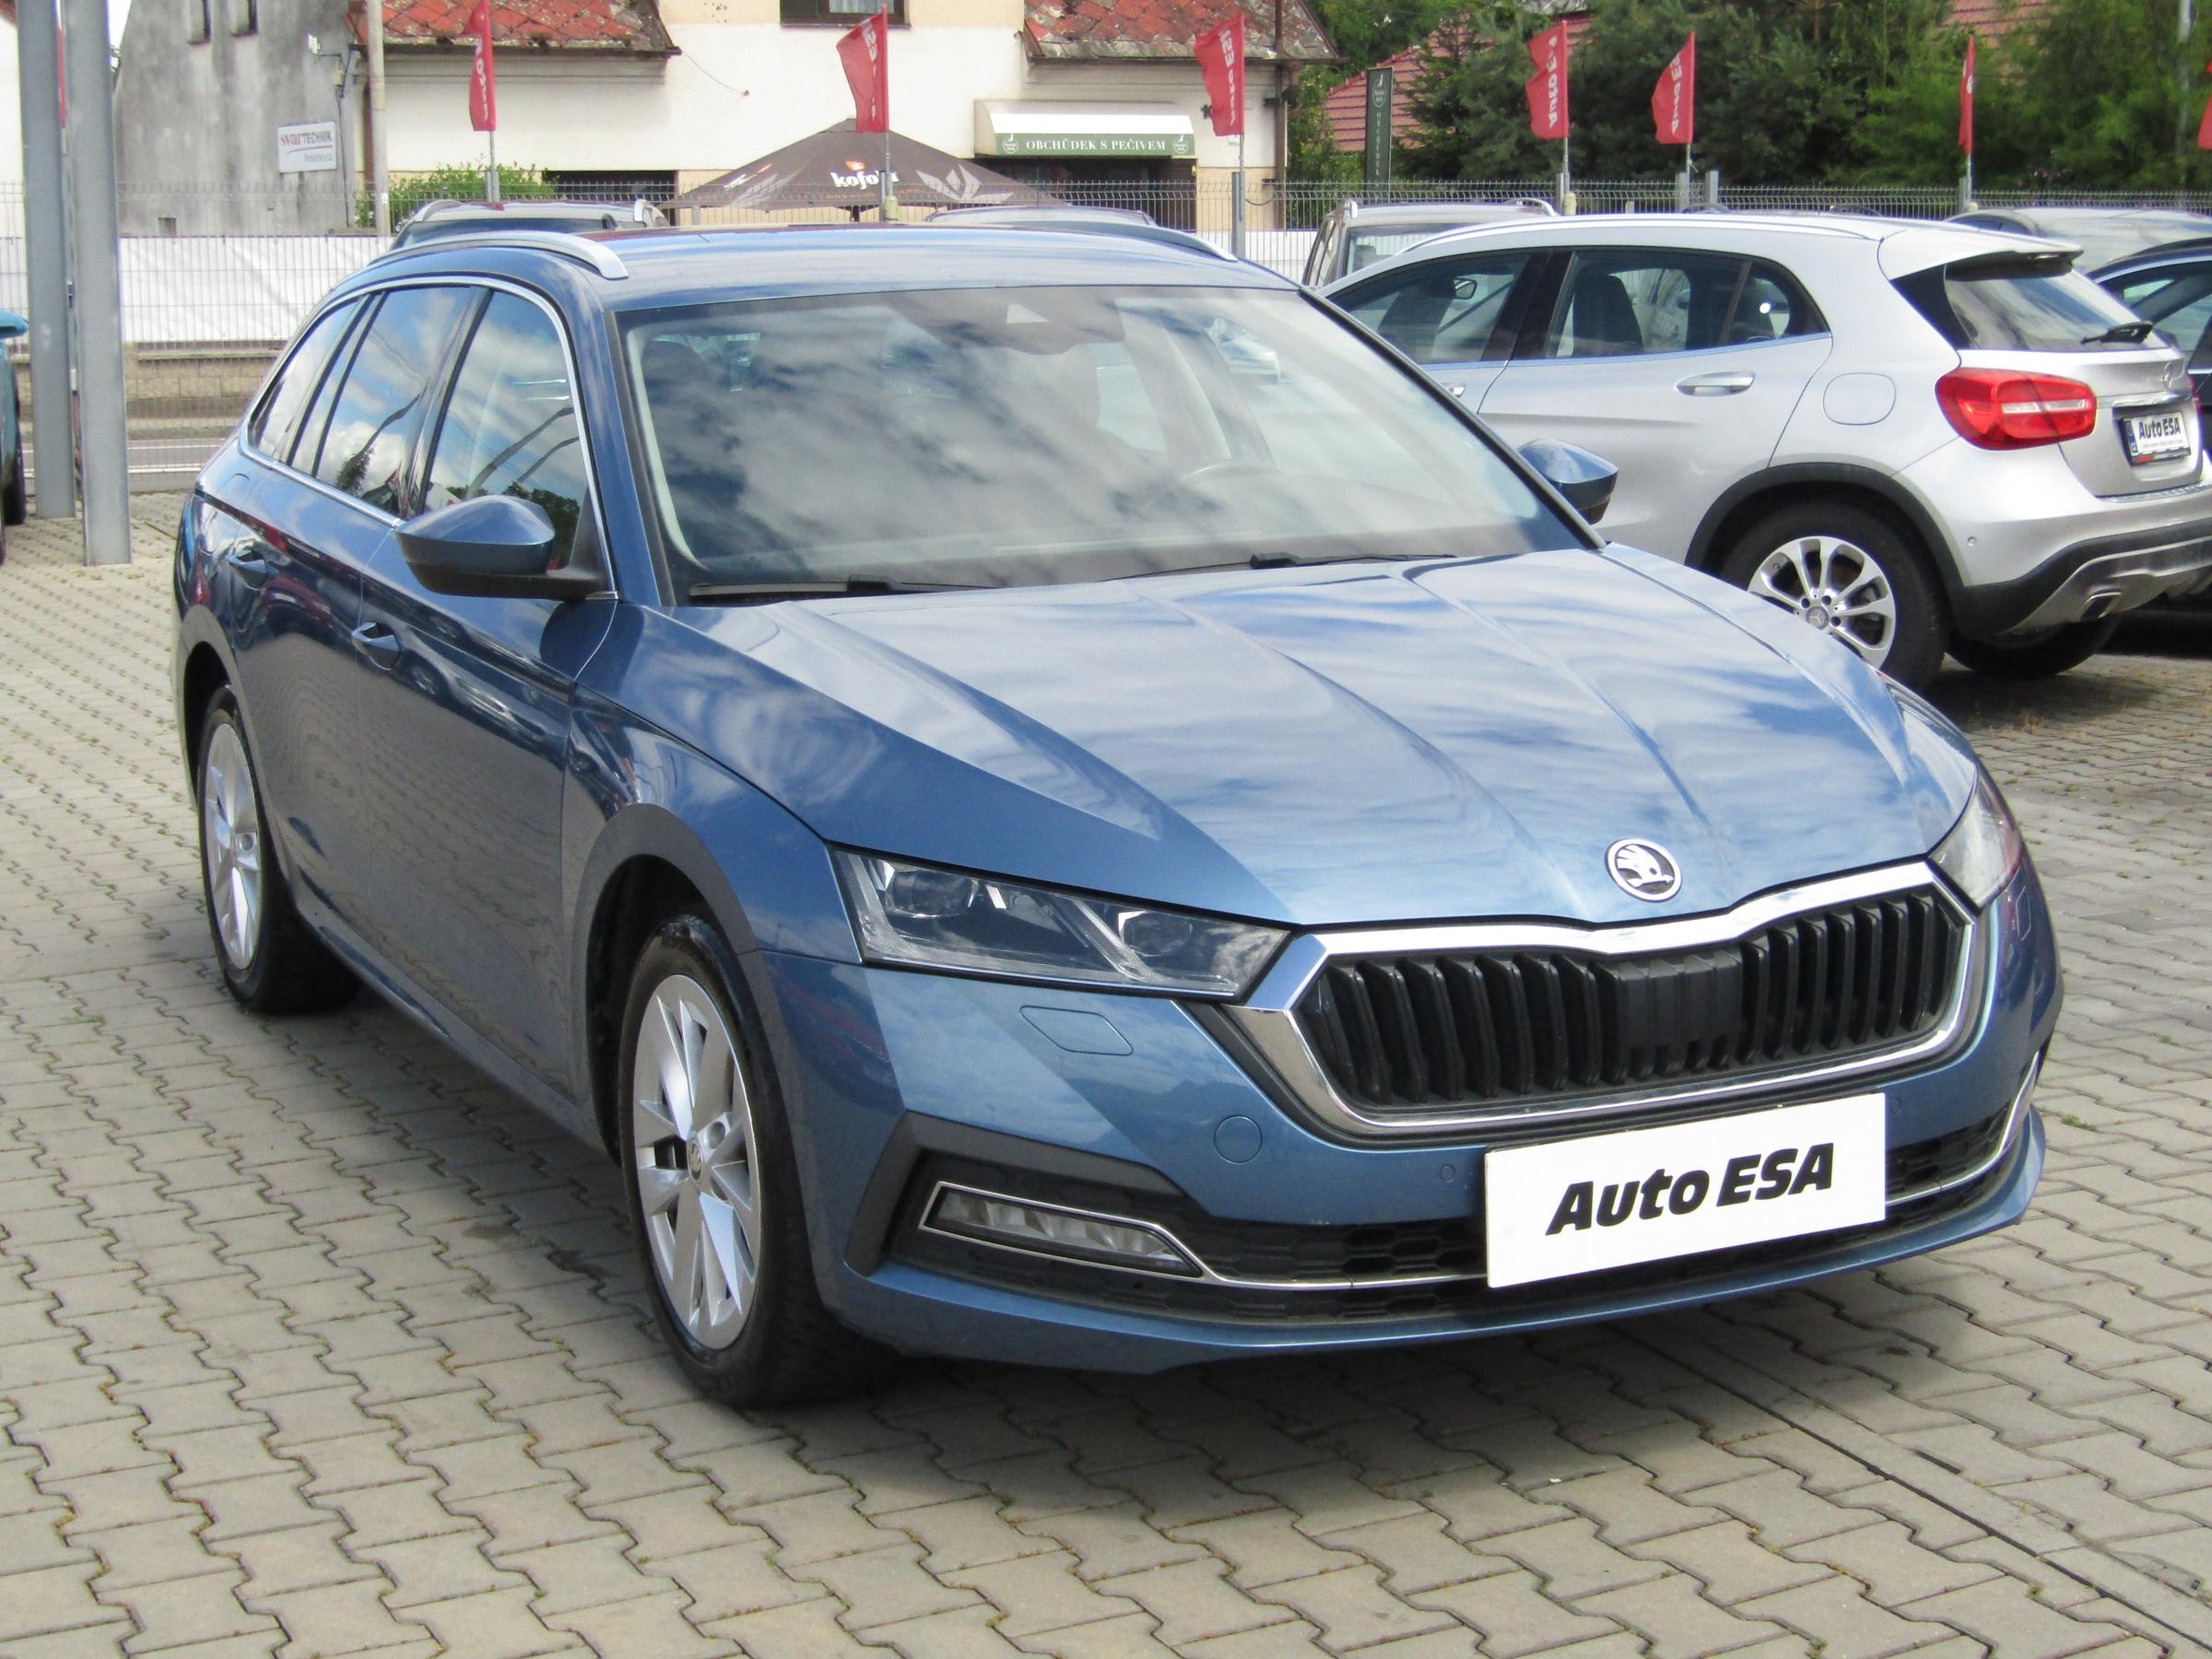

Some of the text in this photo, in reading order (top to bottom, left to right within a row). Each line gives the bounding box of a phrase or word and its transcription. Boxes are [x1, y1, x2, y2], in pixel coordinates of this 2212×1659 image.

[1026, 137, 1097, 150] OBCHŮDEK
[1099, 139, 1107, 150] S
[1112, 137, 1166, 150] PEČIVEM
[830, 171, 900, 190] kofoa
[2138, 417, 2181, 440] Auto ESA
[1545, 1142, 1834, 1236] Auto ESA
